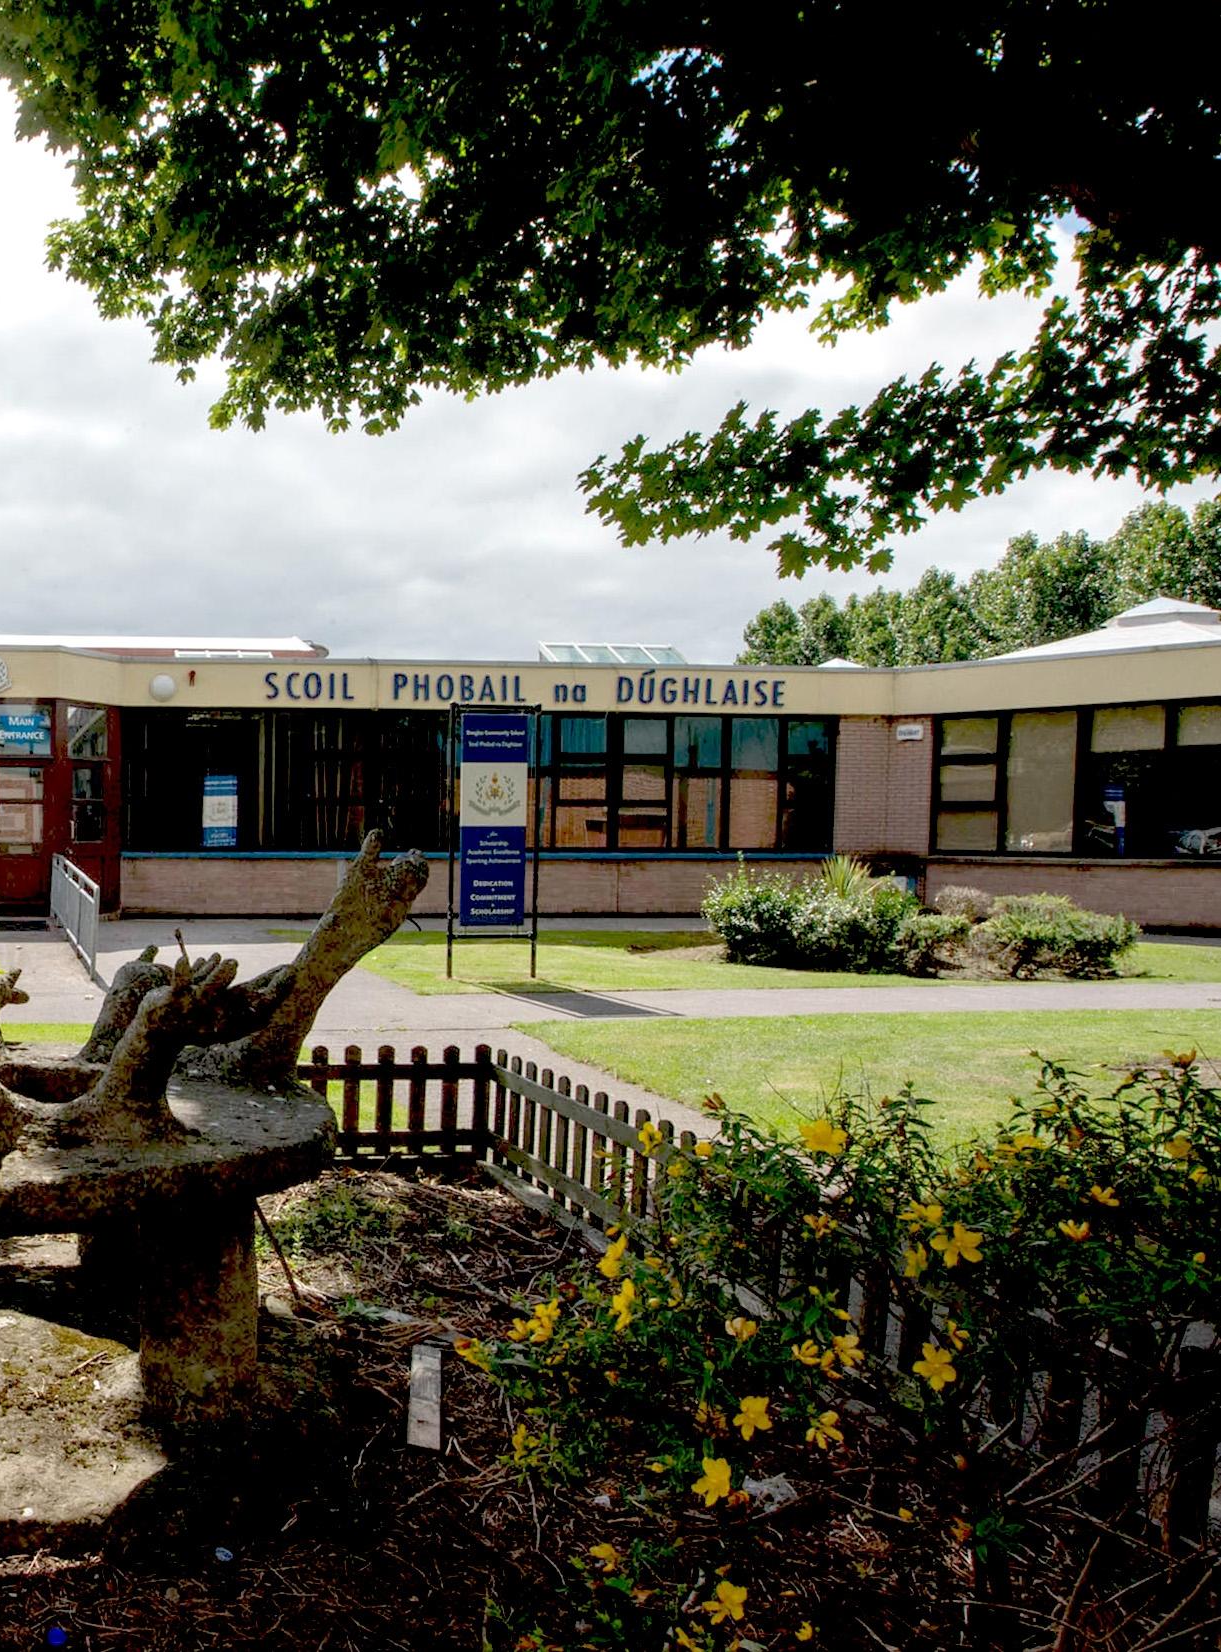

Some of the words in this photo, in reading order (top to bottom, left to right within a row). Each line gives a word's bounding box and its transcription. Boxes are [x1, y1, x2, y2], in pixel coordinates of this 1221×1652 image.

[264, 671, 355, 700] SCOIL
[392, 672, 528, 702] PHOBAIL
[554, 683, 588, 703] na
[616, 668, 787, 707] DÚGHLAISE
[8, 716, 35, 727] MAIN
[472, 879, 514, 887] DEDICATION
[469, 893, 517, 901] COMMITMENT
[469, 907, 516, 916] SCHOLARSHIP
